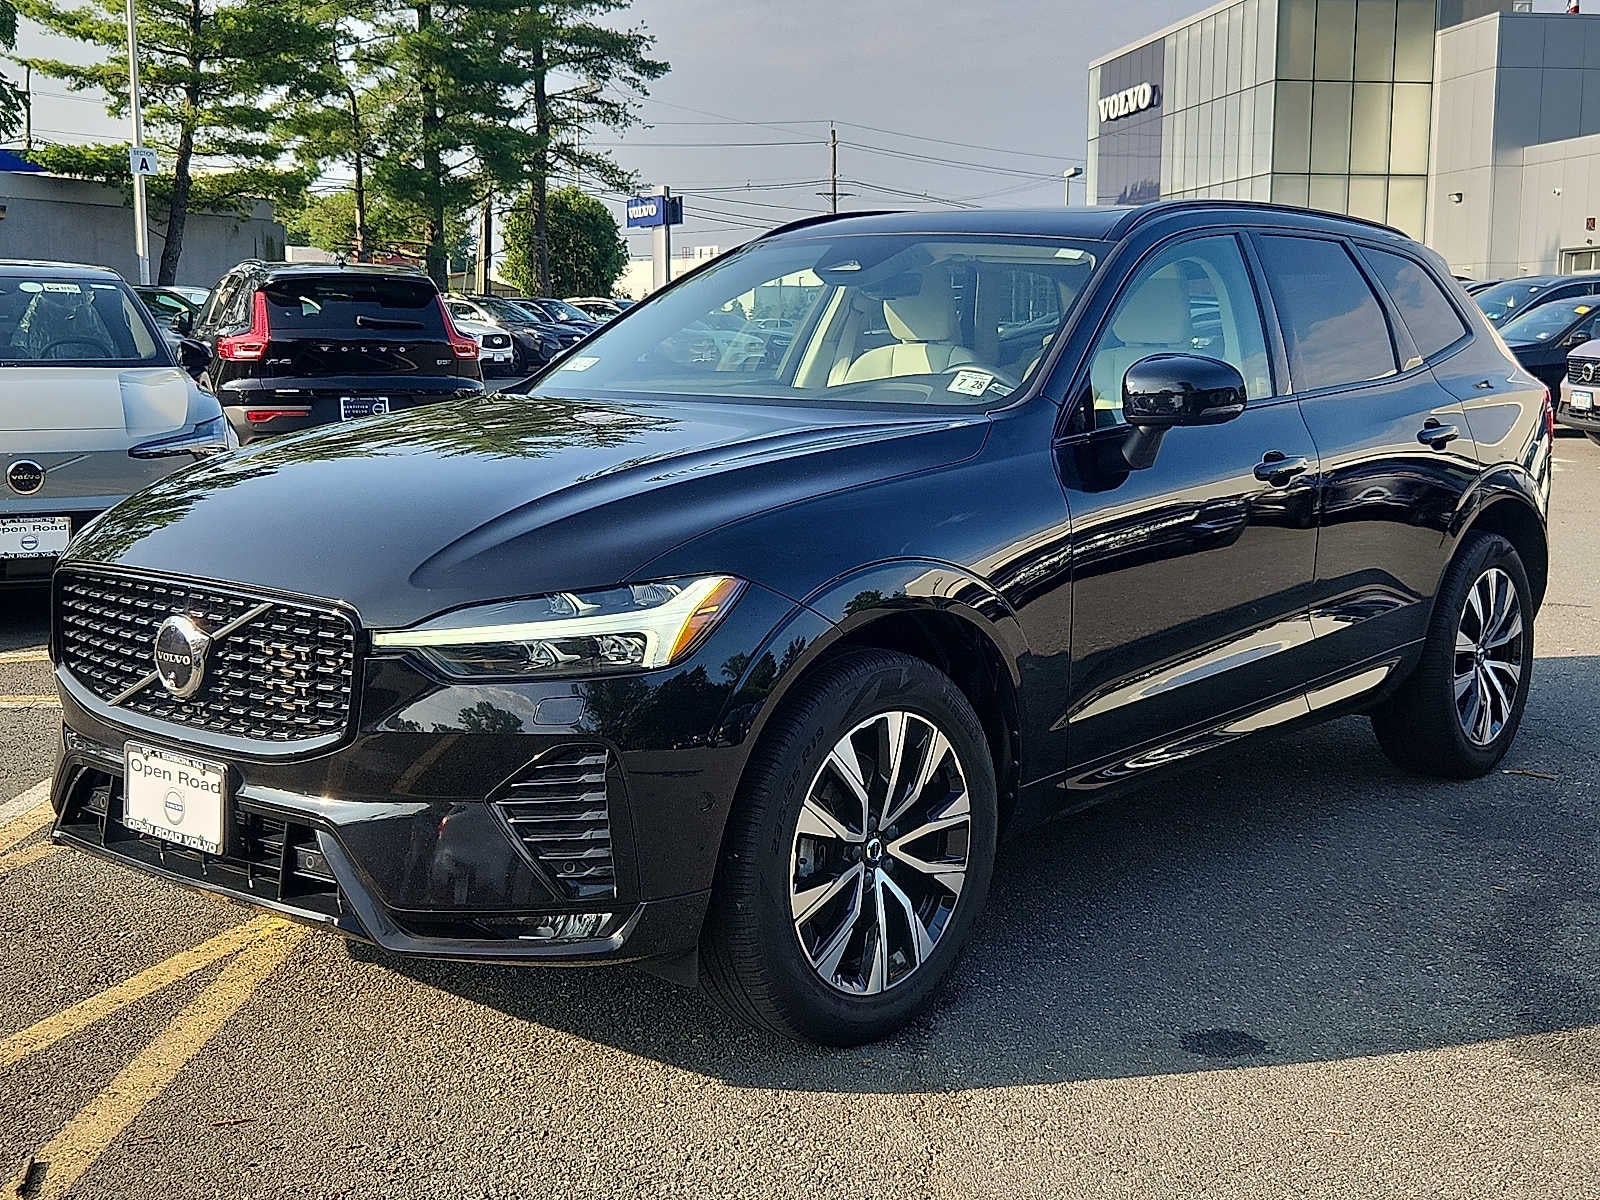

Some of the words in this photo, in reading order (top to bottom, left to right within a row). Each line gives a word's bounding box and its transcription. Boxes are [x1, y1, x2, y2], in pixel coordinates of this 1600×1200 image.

[1098, 82, 1152, 123] VOLVO
[140, 157, 150, 171] A
[628, 204, 657, 219] VOLVO
[958, 378, 967, 387] 7
[971, 380, 986, 390] 28
[11, 473, 41, 481] VOLVO
[0, 526, 27, 535] pen
[32, 524, 67, 532] Road
[157, 650, 191, 665] VOLVO
[131, 758, 172, 782] Open
[178, 771, 221, 794] Road
[127, 818, 154, 835] OPEN
[154, 826, 183, 844] ROAD
[184, 835, 217, 854] VOLVO
